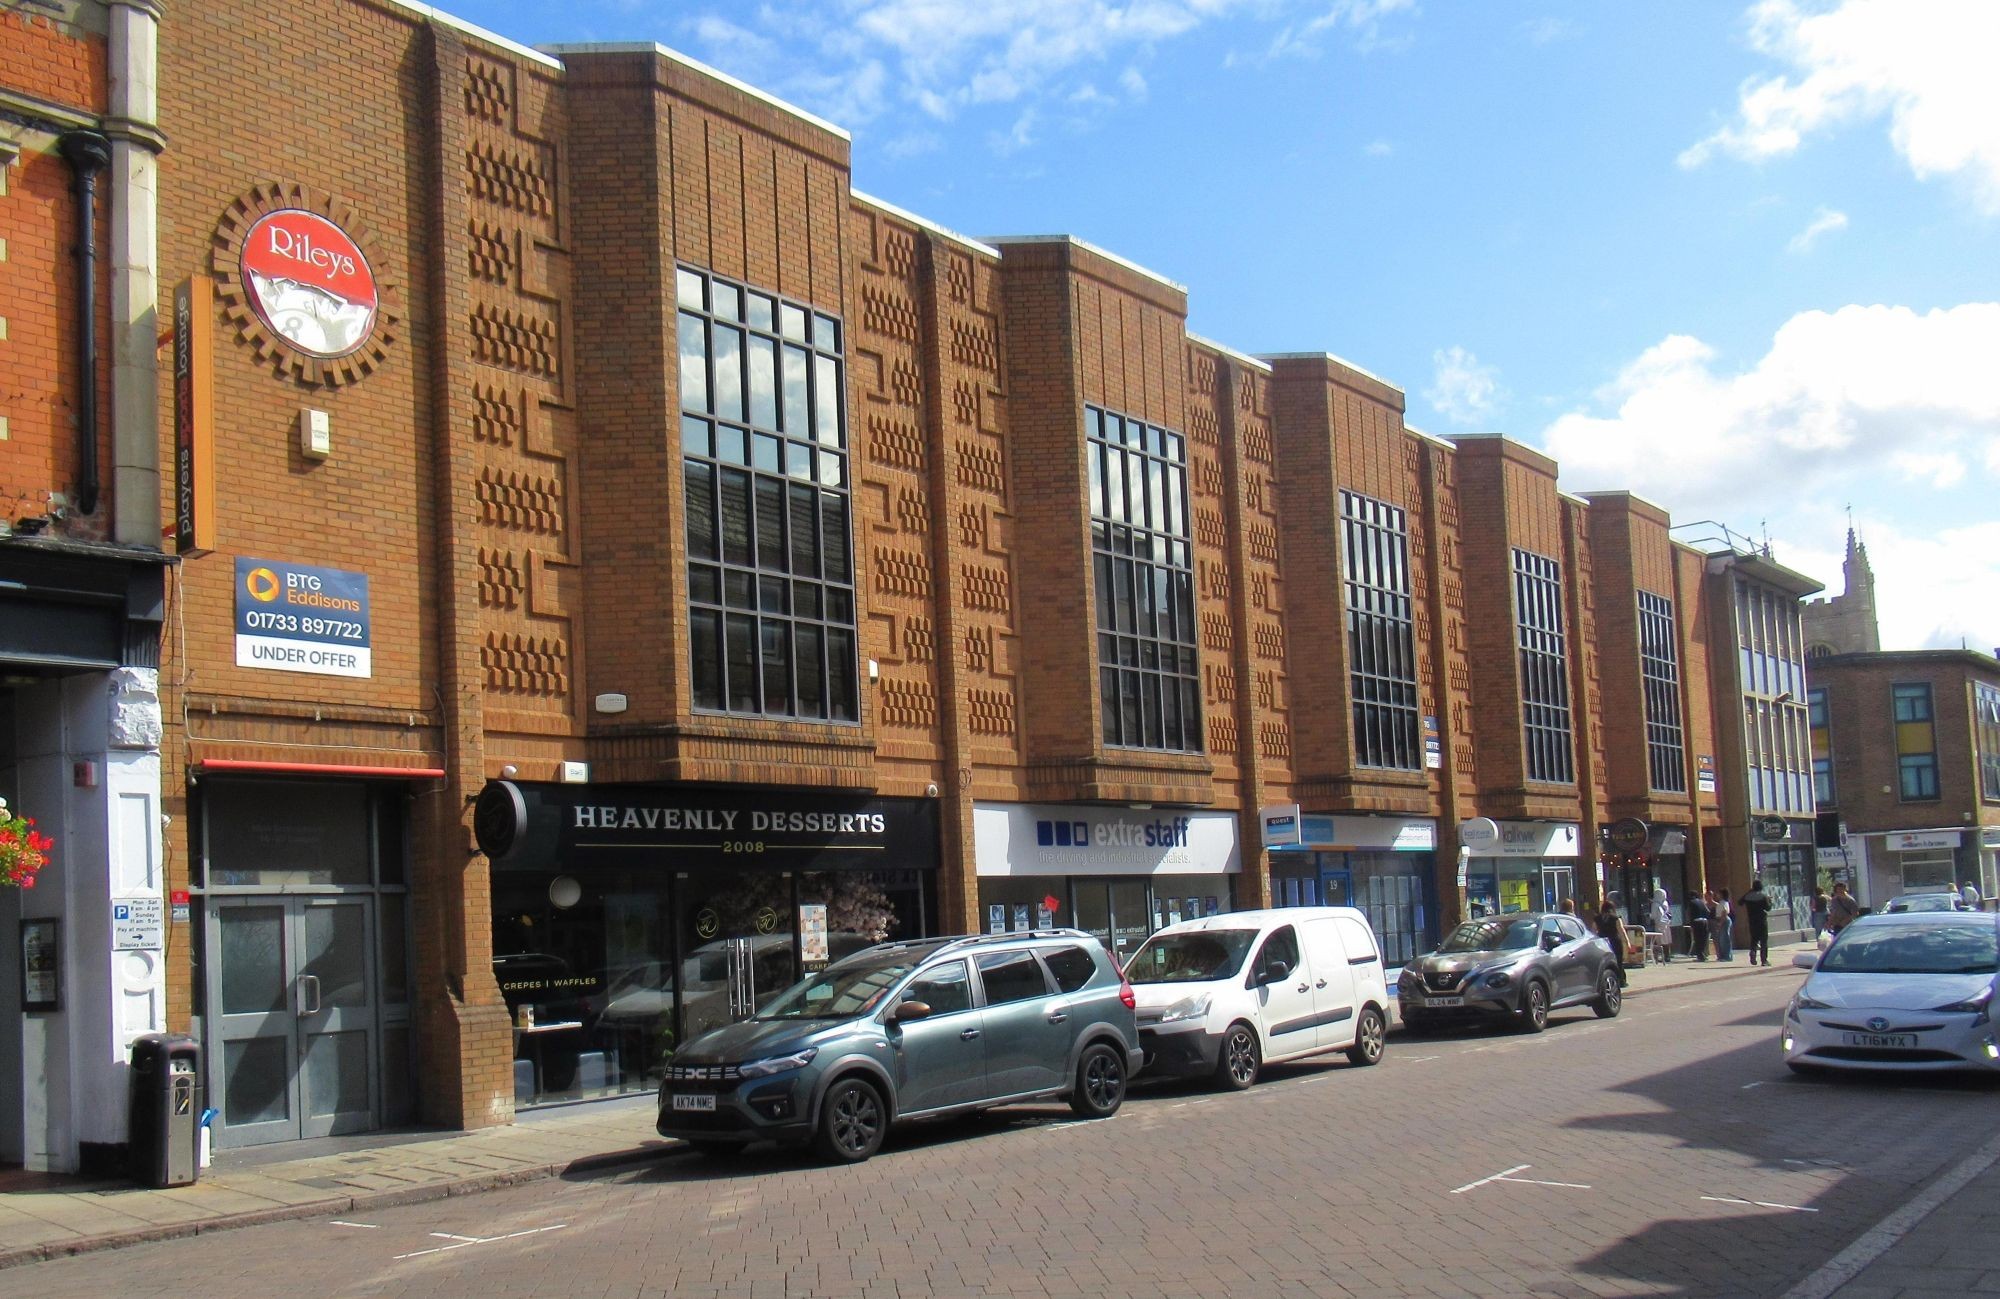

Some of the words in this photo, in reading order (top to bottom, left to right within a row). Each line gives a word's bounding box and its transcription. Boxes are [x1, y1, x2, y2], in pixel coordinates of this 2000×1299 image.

[268, 225, 356, 279] Rileys
[176, 295, 189, 379] lounge
[178, 448, 193, 537] players
[286, 572, 322, 591] BTG
[287, 589, 360, 611] Eddisons
[246, 611, 298, 632] 01733
[302, 617, 363, 639] 897722
[252, 645, 306, 663] UNDER
[309, 650, 357, 668] OFFER
[574, 805, 738, 831] HEAVENLY
[751, 810, 886, 833] DESSERTS
[1094, 816, 1189, 847] extrastaff
[723, 841, 765, 852] 2008
[1039, 852, 1053, 862] the
[1089, 852, 1106, 862] and
[503, 981, 542, 990] CREPES
[553, 977, 597, 987] WAFFLES
